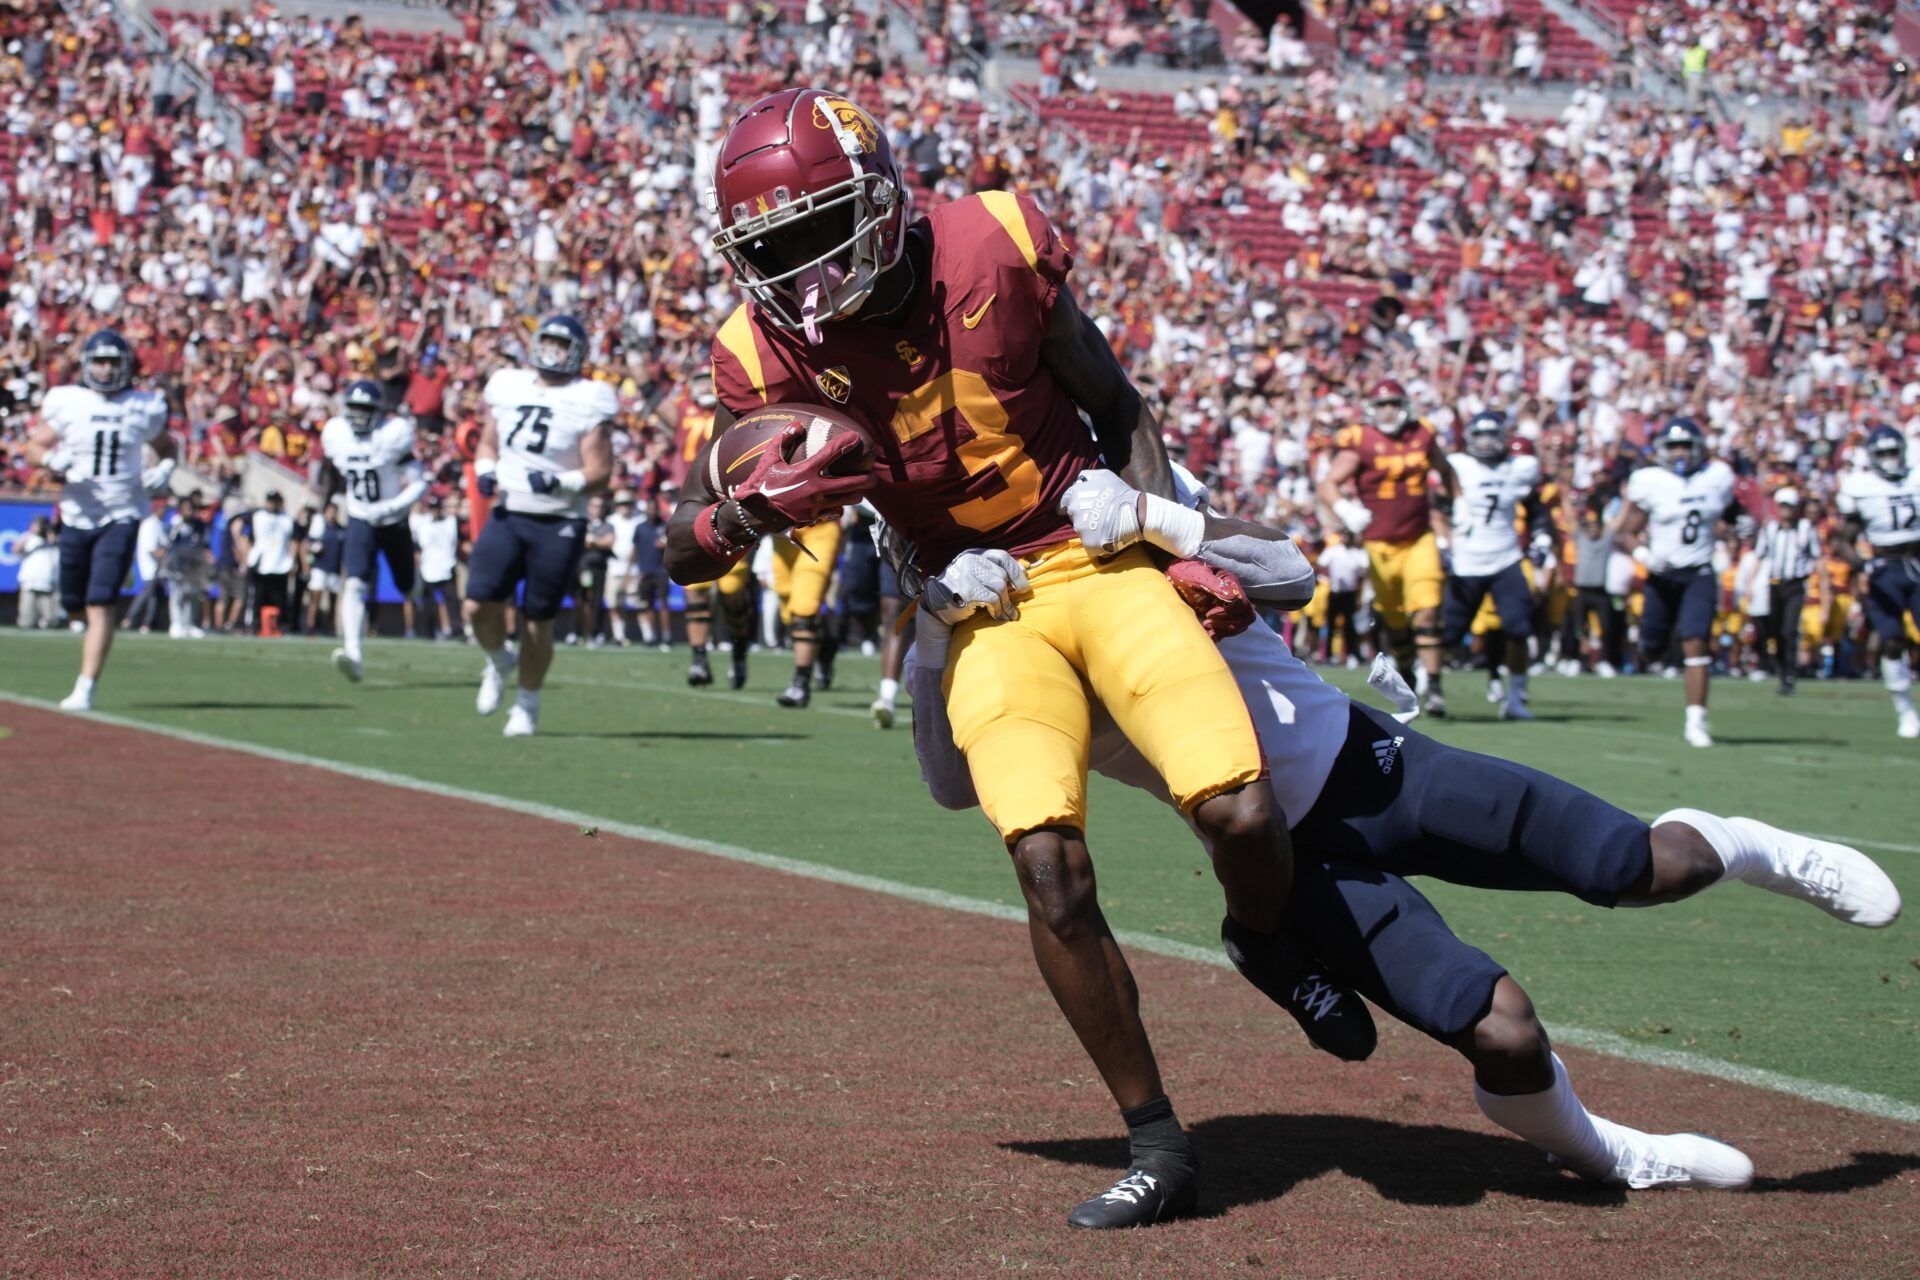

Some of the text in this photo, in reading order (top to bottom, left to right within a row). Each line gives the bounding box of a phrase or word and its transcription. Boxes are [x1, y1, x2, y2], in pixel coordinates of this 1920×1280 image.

[507, 405, 553, 454] 75
[93, 430, 119, 476] 11
[891, 368, 1043, 533] 3
[347, 469, 380, 502] 20
[1089, 487, 1114, 530] adidas
[1485, 494, 1499, 523] 7
[1682, 510, 1701, 545] 8
[1891, 503, 1916, 530] 12
[1383, 736, 1404, 774] adidas
